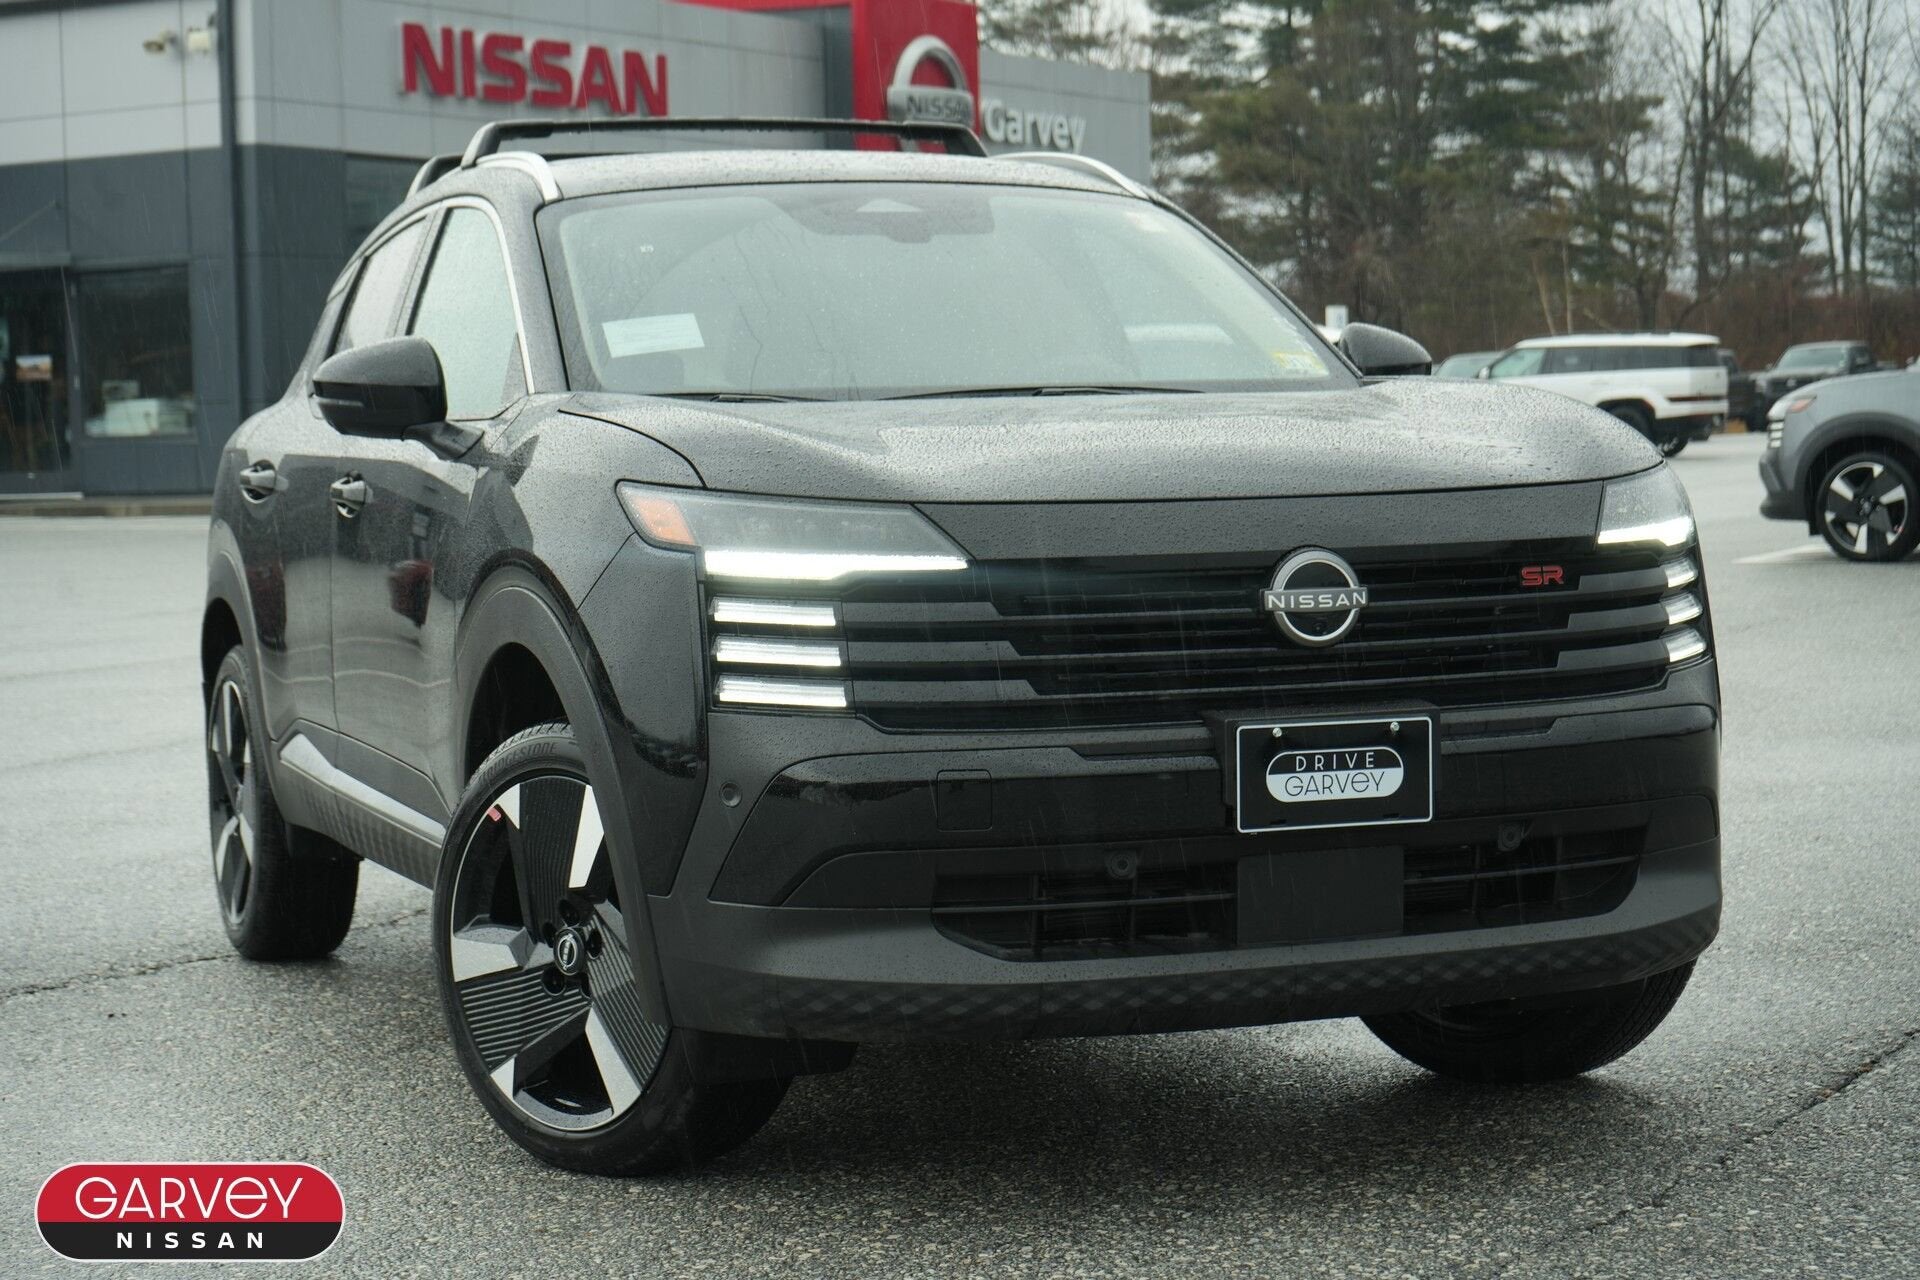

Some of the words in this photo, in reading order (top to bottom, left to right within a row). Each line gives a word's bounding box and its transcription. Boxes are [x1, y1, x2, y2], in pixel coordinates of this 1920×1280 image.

[402, 22, 667, 117] NISSAN
[984, 101, 1086, 152] Garvey
[1521, 565, 1564, 586] SR
[1268, 591, 1366, 609] NISSAN
[1296, 752, 1375, 771] DRIVE
